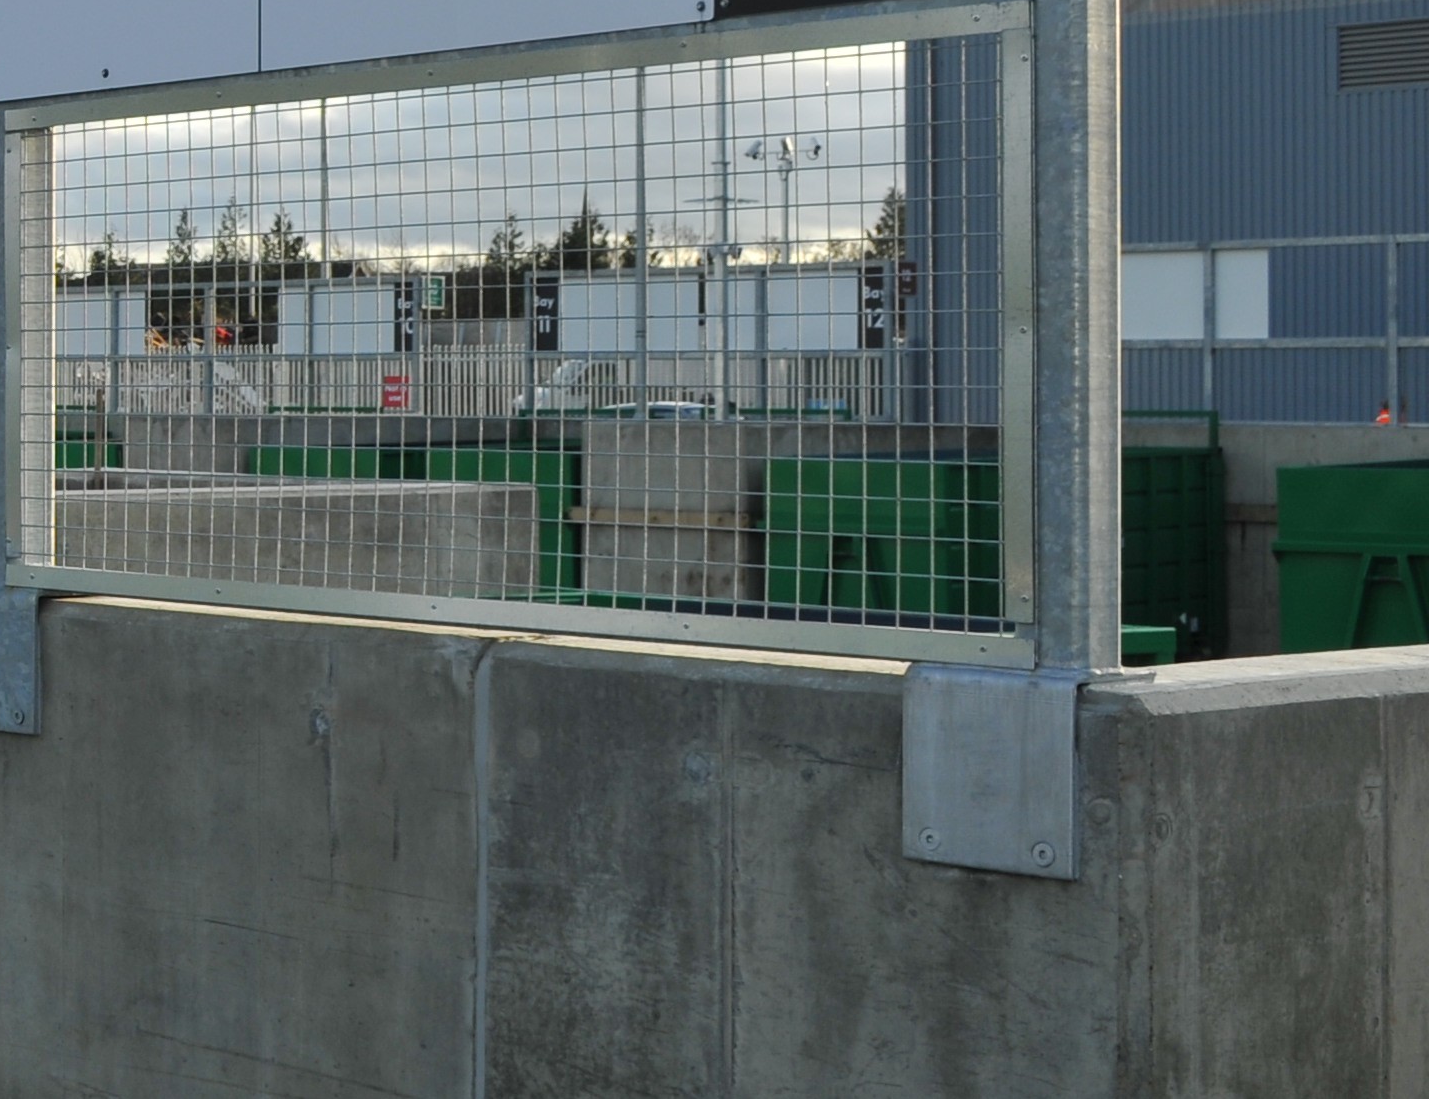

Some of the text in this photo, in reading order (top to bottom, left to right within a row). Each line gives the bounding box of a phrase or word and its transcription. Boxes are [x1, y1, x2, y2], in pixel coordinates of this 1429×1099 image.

[534, 295, 555, 310] Bay
[537, 315, 551, 333] 11
[864, 308, 884, 329] 12
